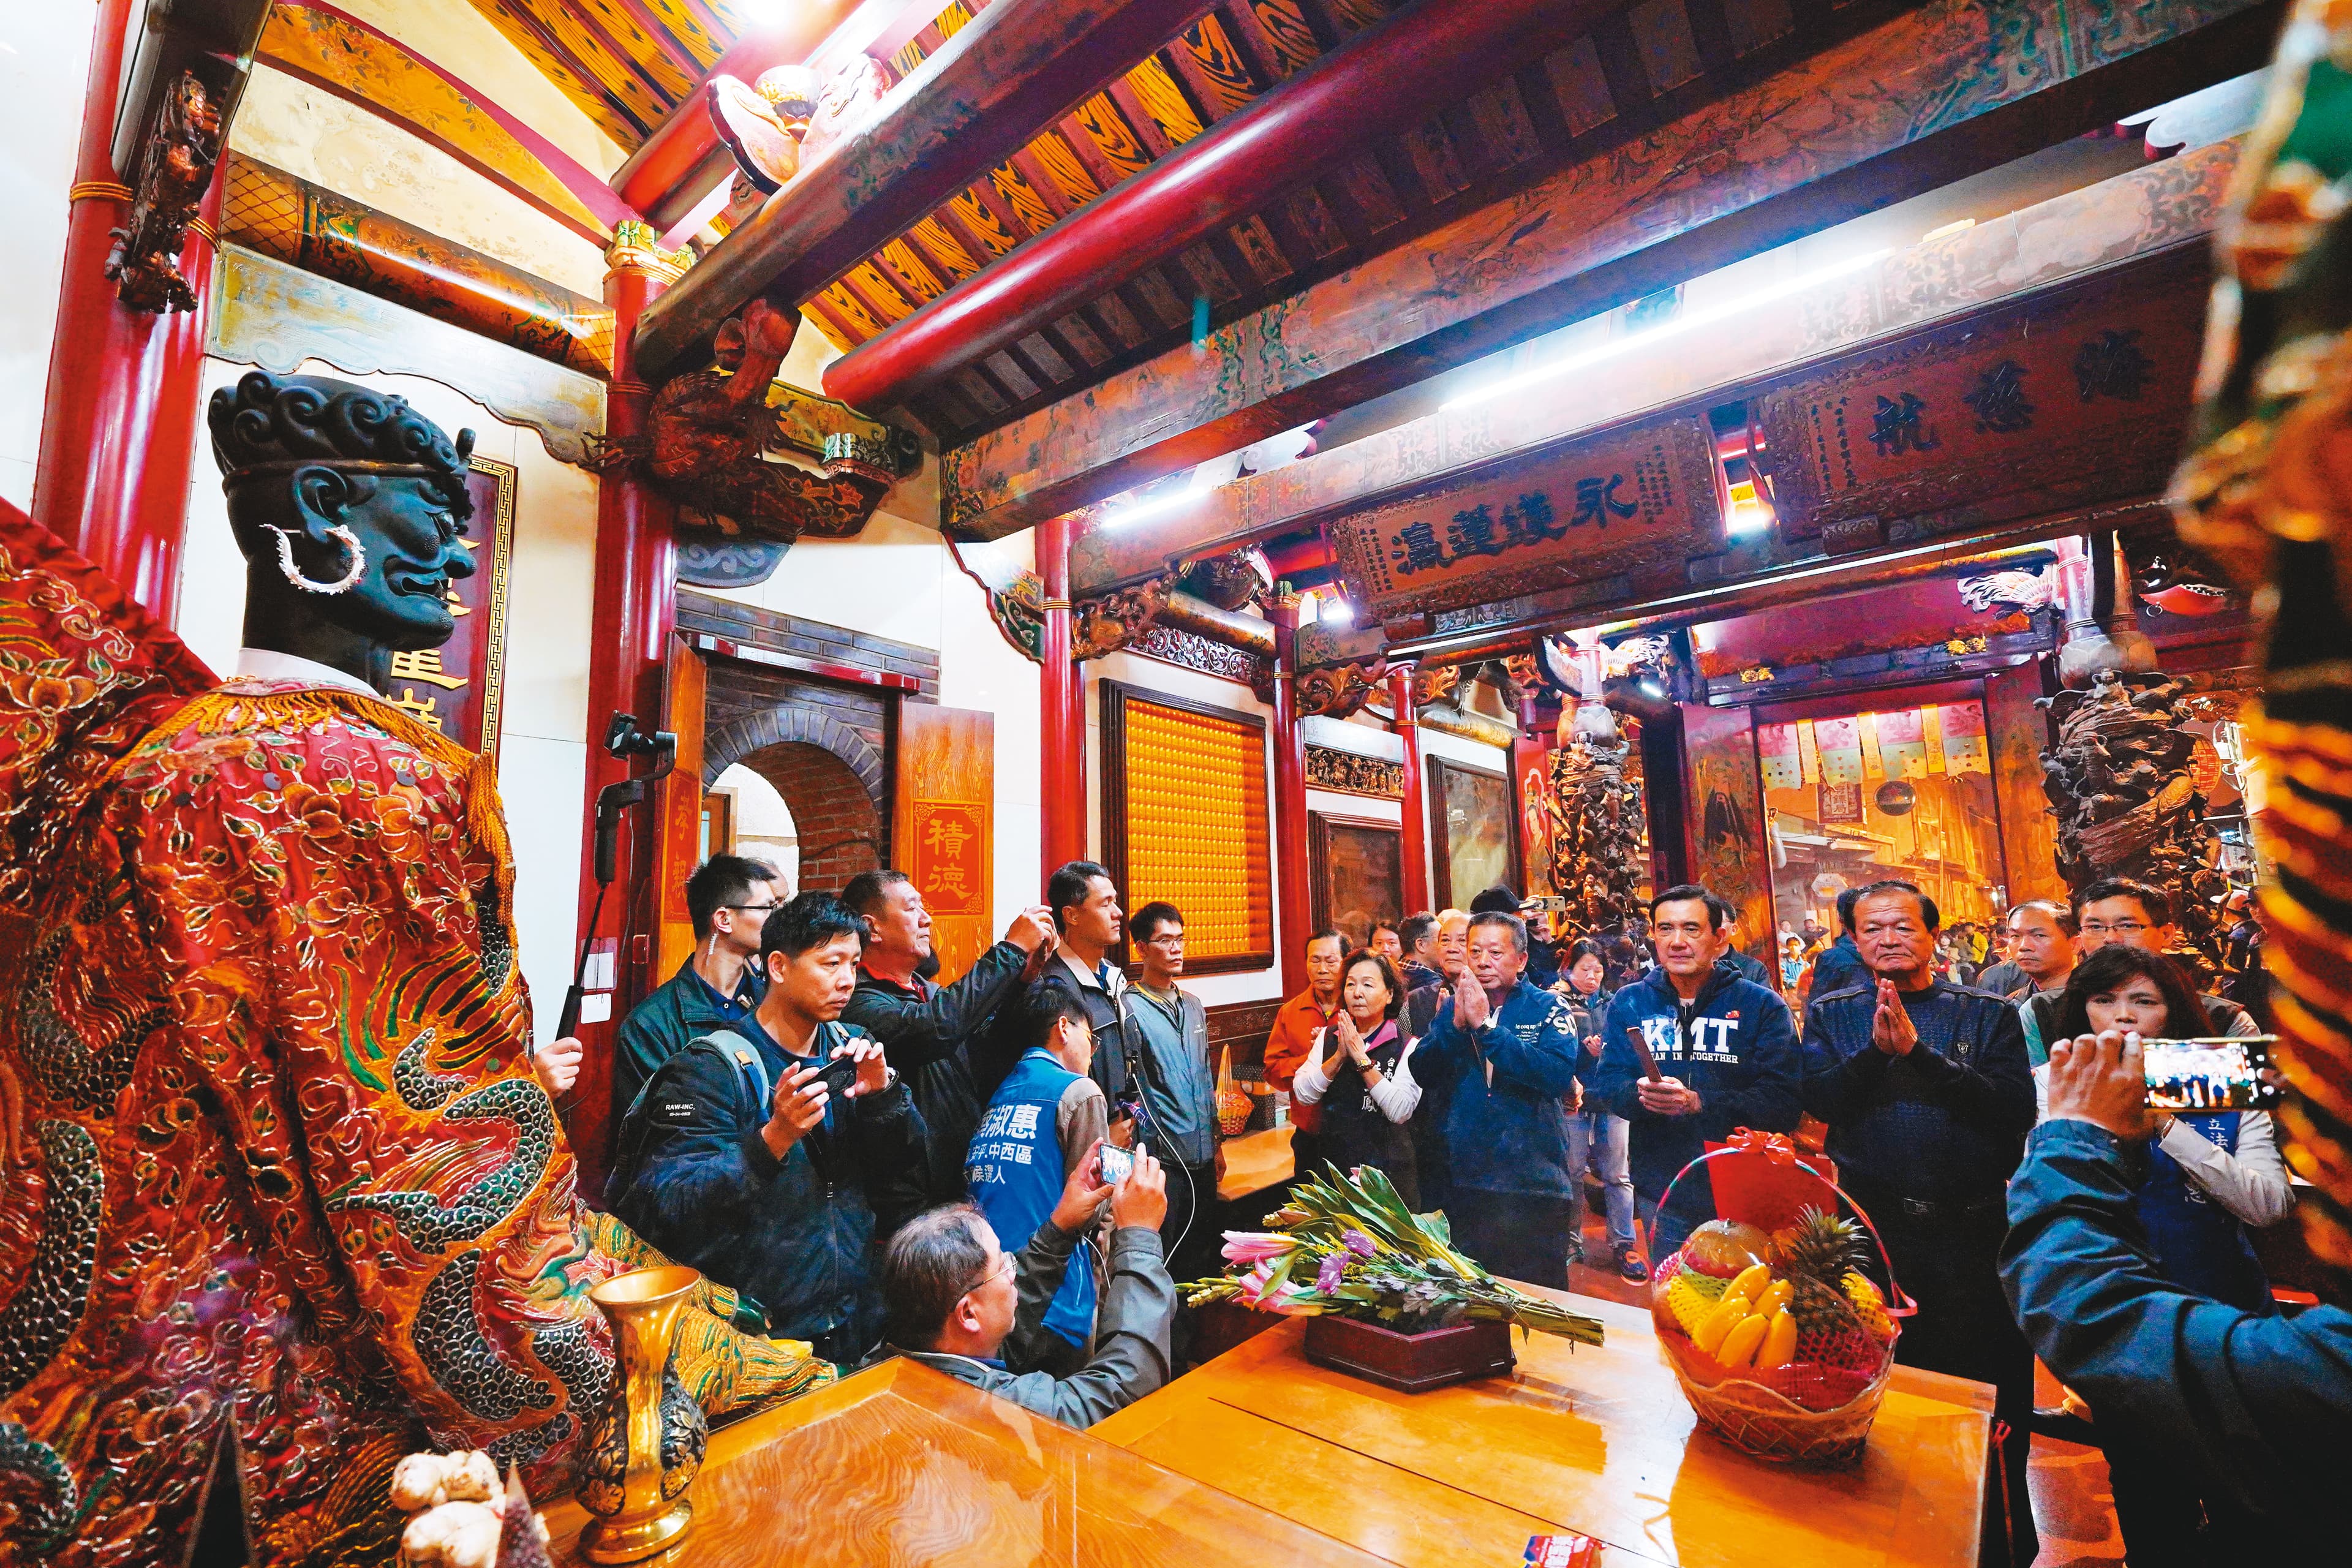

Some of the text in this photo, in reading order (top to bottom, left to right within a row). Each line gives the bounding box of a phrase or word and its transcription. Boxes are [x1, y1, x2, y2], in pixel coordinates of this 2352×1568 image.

[924, 818, 973, 898] 積德
[1642, 1017, 1738, 1054] KMT
[1672, 1052, 1683, 1061] IN
[1692, 1052, 1739, 1064] TOGETHER
